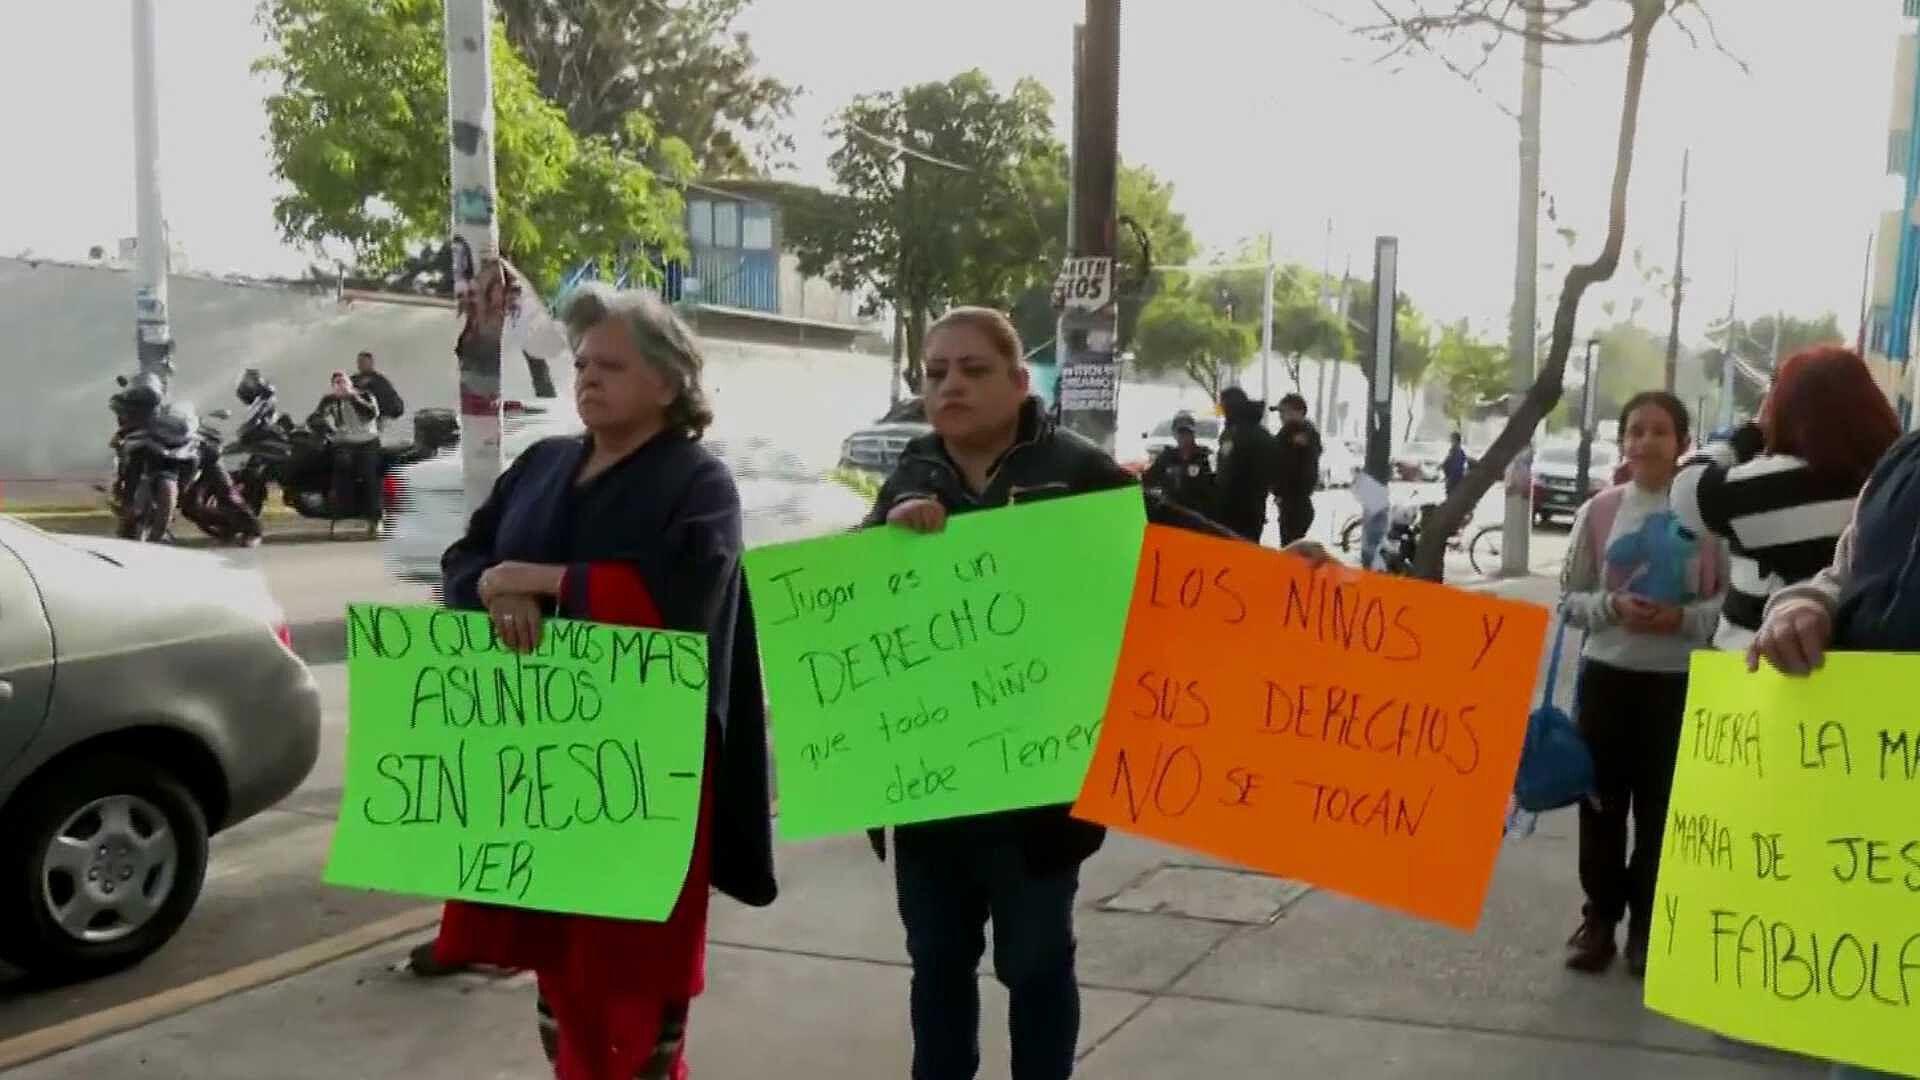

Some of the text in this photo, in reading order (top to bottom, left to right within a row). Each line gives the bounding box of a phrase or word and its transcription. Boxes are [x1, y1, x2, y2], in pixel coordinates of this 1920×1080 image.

[769, 550, 998, 626] Jugar es un
[1149, 549, 1248, 625] LOS
[1282, 568, 1422, 662] NIÑOS
[348, 607, 708, 690] NO QUMOS MAS
[798, 592, 1026, 709] DERECHO
[410, 655, 602, 728] ASUNTOS
[1133, 670, 1481, 775] SUS DERECHOS
[801, 733, 851, 770] que
[879, 702, 950, 743] todo
[886, 719, 1102, 805] debe Tener
[1693, 706, 1764, 779] FUERA
[1799, 720, 1851, 775] LA
[363, 739, 468, 828] SIN
[1111, 744, 1435, 837] NO SE TOCAN
[457, 840, 535, 900] VER
[1670, 809, 1733, 872] MARIA
[1752, 831, 1791, 882] DE
[1664, 894, 1920, 1007] Y FABIOLA
